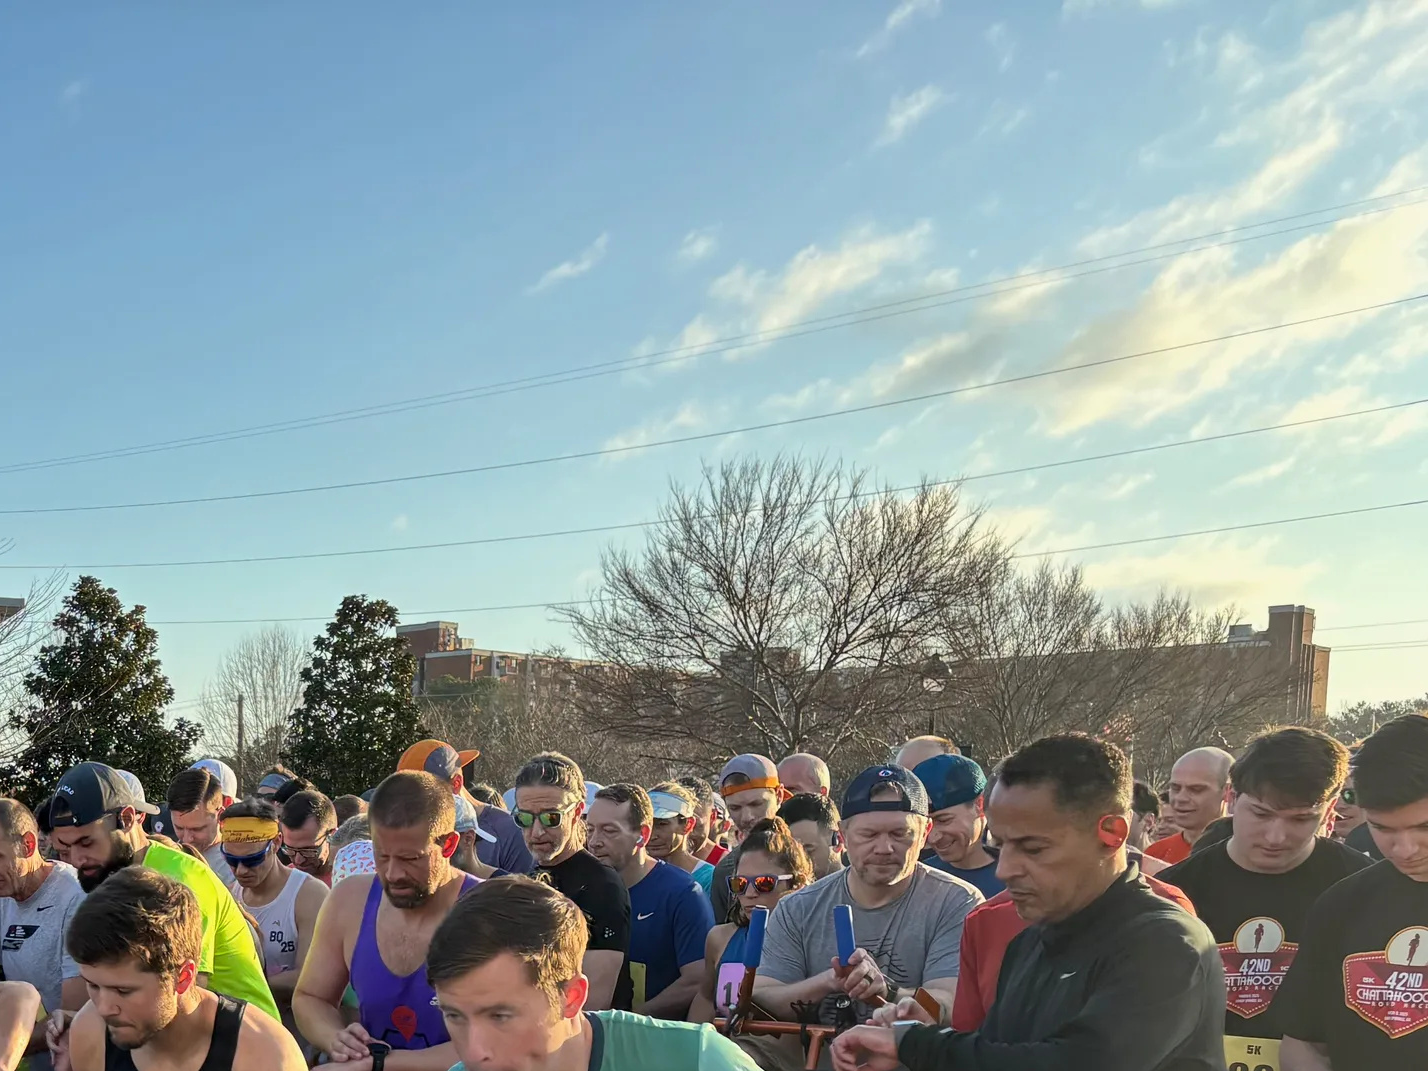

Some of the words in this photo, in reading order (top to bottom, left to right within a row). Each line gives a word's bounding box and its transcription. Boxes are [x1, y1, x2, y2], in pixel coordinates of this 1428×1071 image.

[269, 931, 283, 943] BQ
[281, 941, 295, 953] 25
[1239, 958, 1271, 976] 42ND
[1385, 971, 1423, 990] 42ND
[1246, 1045, 1262, 1055] 5K
